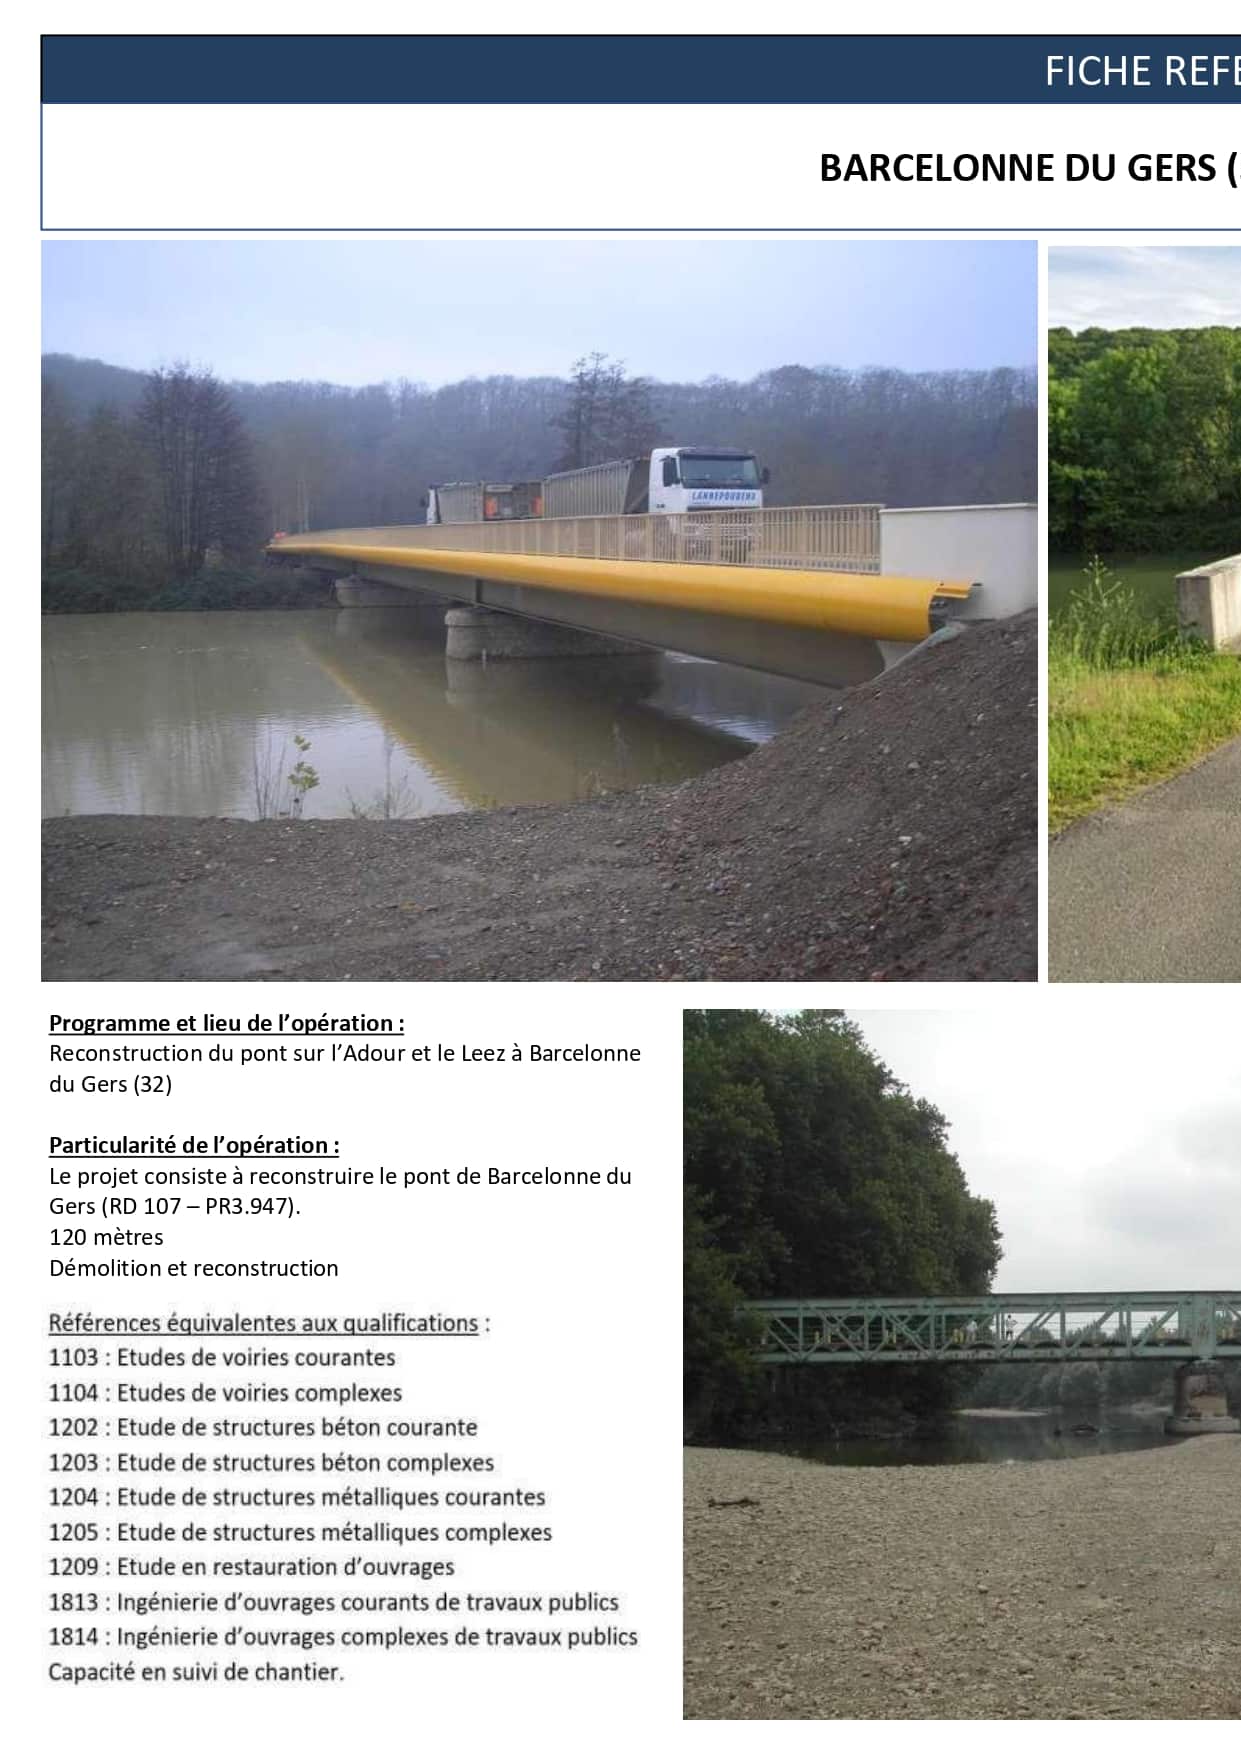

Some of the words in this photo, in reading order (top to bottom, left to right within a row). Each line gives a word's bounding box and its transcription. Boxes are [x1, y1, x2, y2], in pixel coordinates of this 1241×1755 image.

[1047, 55, 1151, 86] FICHE
[821, 153, 1055, 182] BARCELONNE
[1066, 153, 1116, 182] DU
[1127, 153, 1217, 182] GERS
[49, 1014, 171, 1037] Programme
[176, 1015, 197, 1033] et
[203, 1013, 241, 1033] lieu
[247, 1013, 273, 1033] de
[278, 1012, 393, 1037] l’opération
[50, 1044, 203, 1062] Reconstruction
[208, 1043, 233, 1062] du
[241, 1045, 288, 1066] pont
[293, 1048, 325, 1062] sur
[332, 1043, 406, 1062] l’Adour
[411, 1045, 432, 1062] et
[438, 1043, 455, 1062] le
[462, 1044, 506, 1062] Leez
[511, 1042, 522, 1062] à
[530, 1043, 641, 1062] Barcelonne
[49, 1074, 75, 1093] du
[81, 1075, 128, 1093] Gers
[134, 1074, 172, 1097] (32)
[50, 1134, 177, 1155] Particularité
[182, 1135, 209, 1155] de
[213, 1134, 328, 1159] l’opération
[50, 1167, 72, 1185] Le
[78, 1167, 139, 1189] projet
[144, 1167, 227, 1185] consiste
[232, 1165, 243, 1185] à
[250, 1167, 374, 1185] reconstruire
[380, 1166, 397, 1185] le
[404, 1168, 451, 1189] pont
[456, 1166, 481, 1185] de
[488, 1166, 601, 1185] Barcelonne
[606, 1166, 631, 1185] du
[49, 1197, 96, 1215] Gers
[102, 1196, 137, 1219] (RD
[144, 1197, 182, 1215] 107
[206, 1196, 301, 1219] PR3.947).
[50, 1228, 87, 1246] 120
[94, 1226, 164, 1246] mètres
[50, 1257, 161, 1277] Démolition
[167, 1260, 188, 1277] et
[194, 1259, 339, 1277] reconstruction
[49, 1311, 161, 1333] Références
[166, 1312, 297, 1337] équivalentes
[302, 1317, 338, 1333] aux
[343, 1312, 479, 1337] qualifications
[49, 1347, 99, 1367] 1103
[118, 1347, 186, 1367] Etudes
[191, 1347, 217, 1367] de
[222, 1347, 289, 1367] voiries
[294, 1349, 396, 1367] courantes
[50, 1417, 98, 1437] 1202
[118, 1417, 176, 1437] Etude
[181, 1416, 207, 1437] de
[213, 1419, 316, 1437] structures
[321, 1416, 381, 1437] béton
[387, 1419, 478, 1437] courante
[50, 1453, 99, 1472] 1203
[117, 1452, 176, 1472] Etude
[181, 1452, 207, 1472] de
[213, 1454, 316, 1473] structures
[321, 1451, 381, 1473] béton
[387, 1452, 495, 1476] complexes
[49, 1522, 99, 1542] 1205
[118, 1522, 176, 1542] Etude
[181, 1522, 208, 1542] de
[213, 1523, 316, 1542] structures
[321, 1521, 440, 1546] métalliques
[445, 1522, 553, 1545] complexes
[49, 1557, 99, 1577] 1209
[118, 1556, 176, 1576] Etude
[181, 1561, 207, 1576] en
[213, 1556, 337, 1576] restauration
[344, 1556, 455, 1581] d’ouvrages
[50, 1592, 98, 1612] 1813
[118, 1591, 219, 1616] Ingénierie
[224, 1591, 336, 1616] d’ouvrages
[341, 1593, 430, 1612] courants
[435, 1591, 460, 1612] de
[466, 1593, 543, 1612] travaux
[548, 1591, 619, 1616] publics
[50, 1627, 99, 1646] 1814
[118, 1625, 218, 1650] Ingénierie
[224, 1626, 336, 1651] d’ouvrages
[341, 1626, 449, 1650] complexes
[454, 1626, 480, 1646] de
[485, 1628, 562, 1646] travaux
[568, 1626, 638, 1650] publics
[48, 1660, 136, 1685] Capacité
[141, 1666, 166, 1681] en
[172, 1662, 218, 1681] suivi
[224, 1661, 249, 1681] de
[255, 1661, 344, 1681] chantier.
